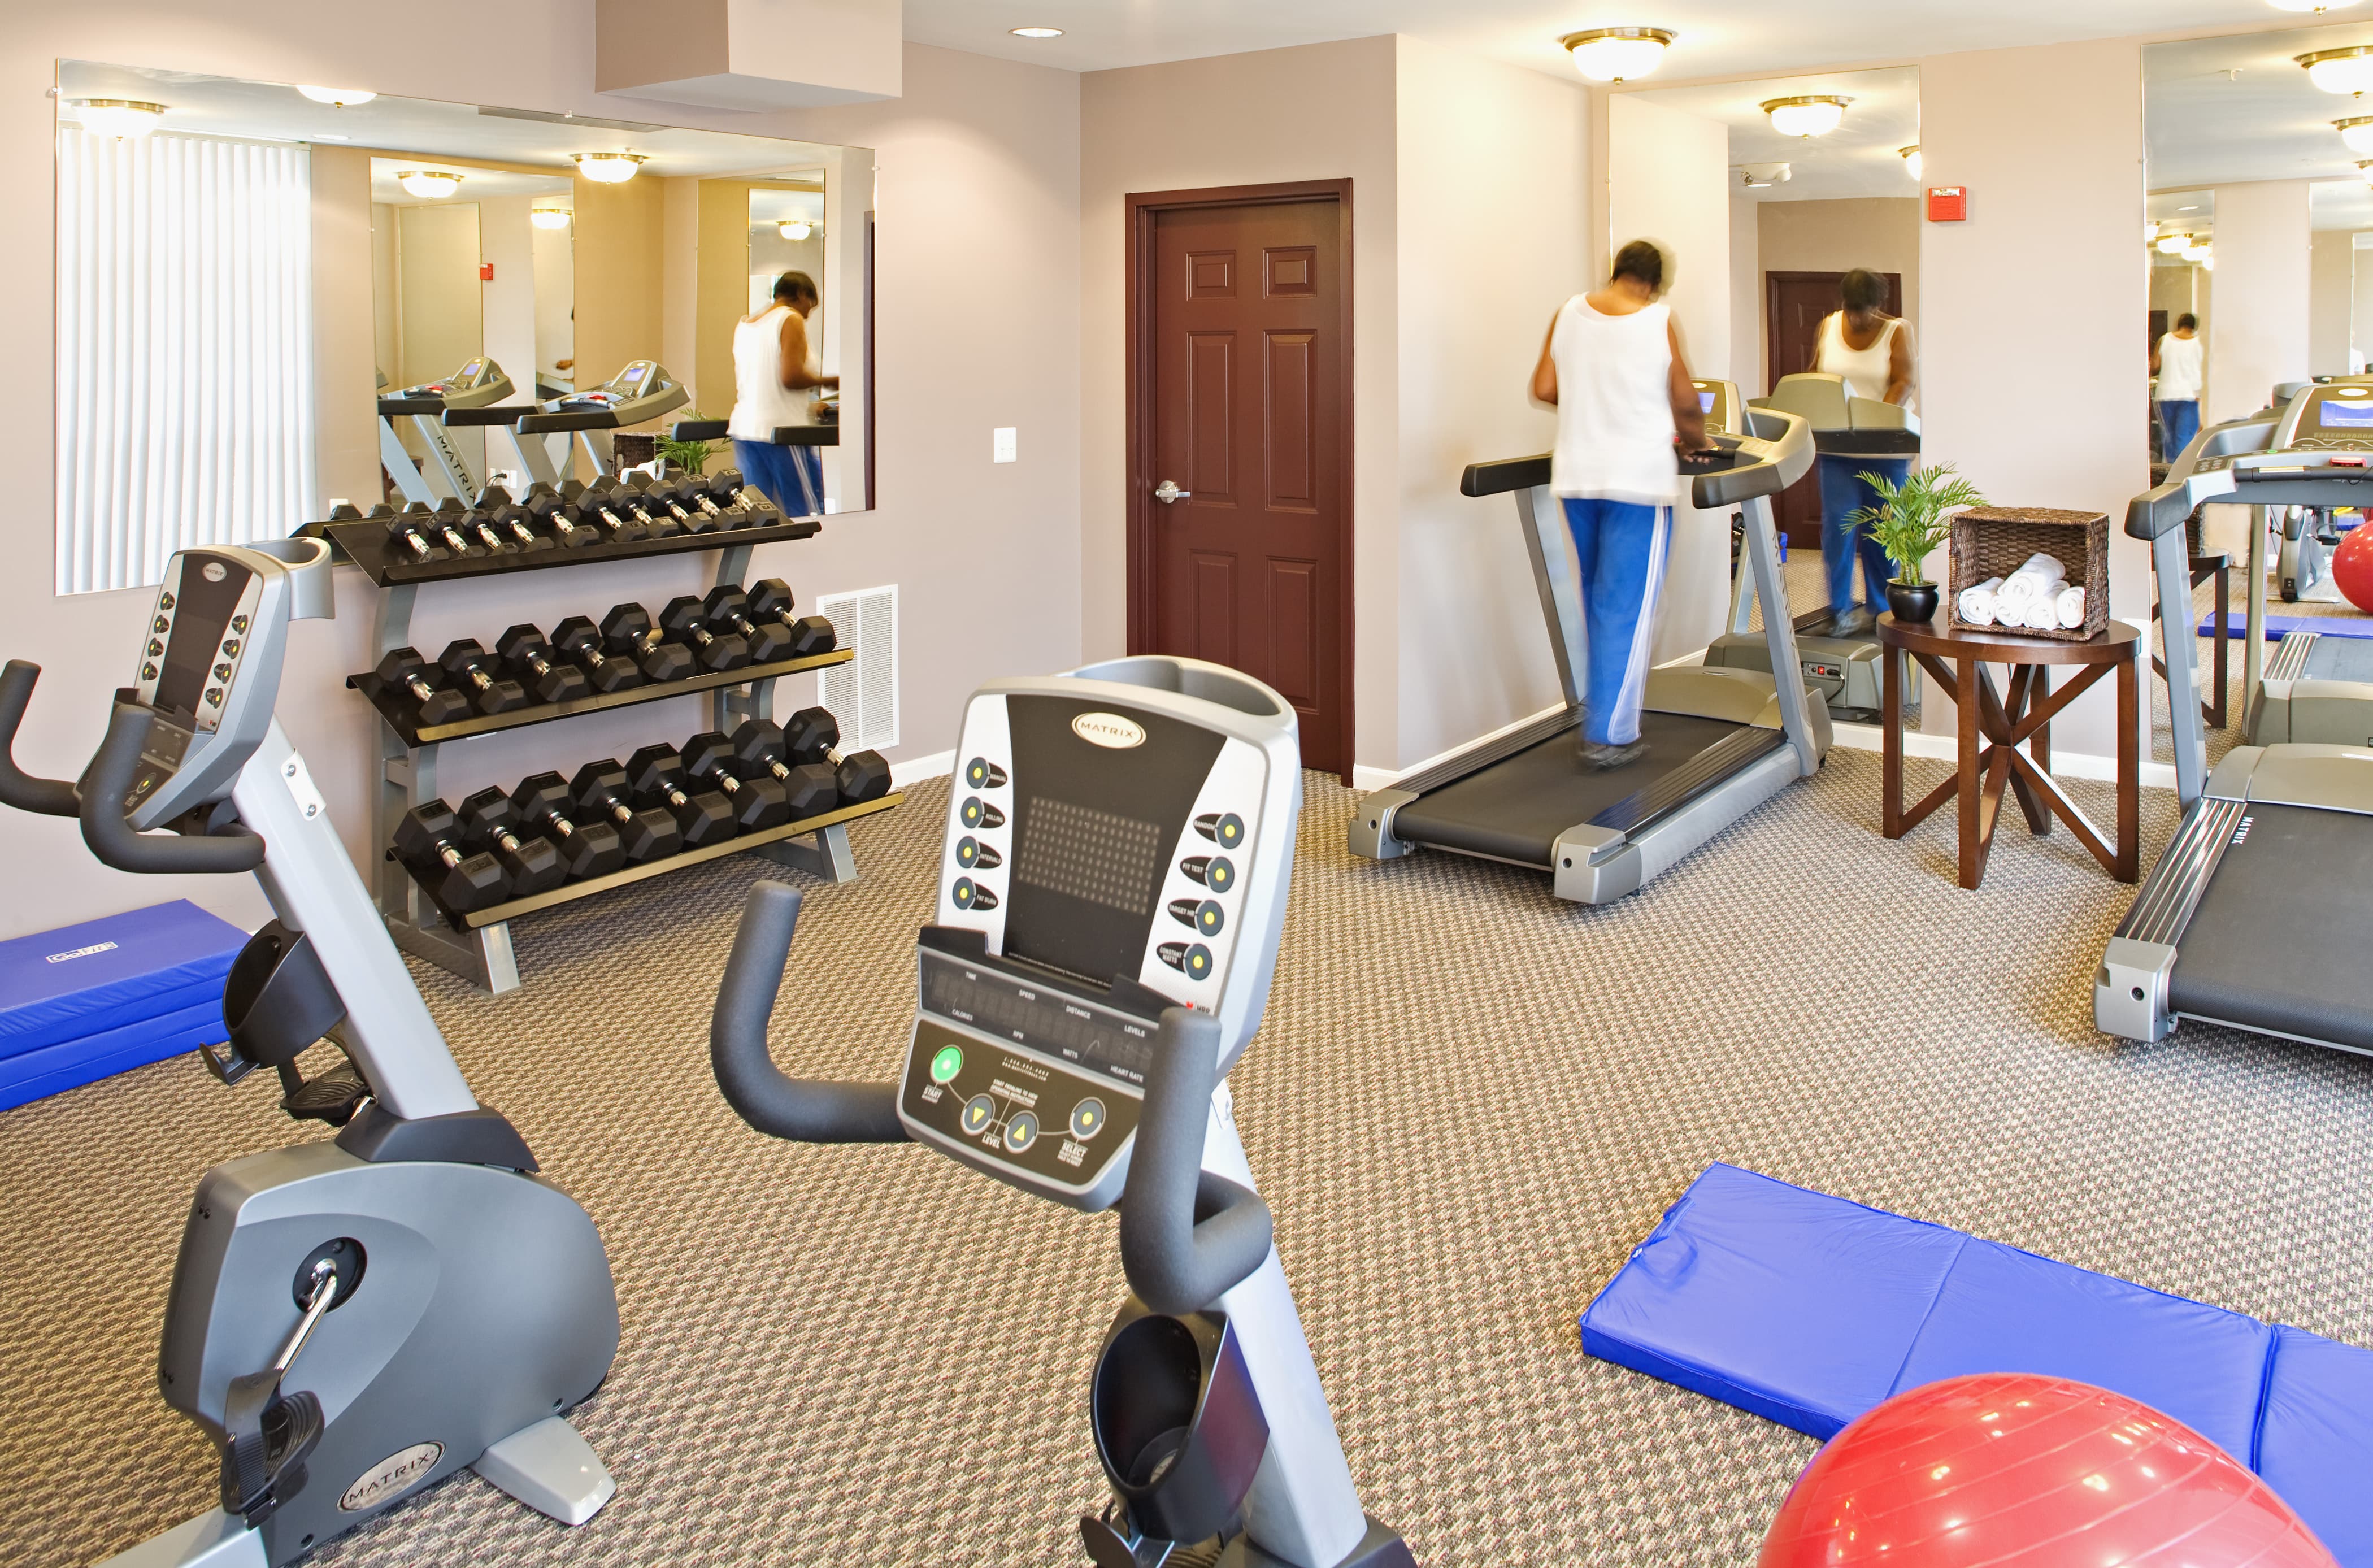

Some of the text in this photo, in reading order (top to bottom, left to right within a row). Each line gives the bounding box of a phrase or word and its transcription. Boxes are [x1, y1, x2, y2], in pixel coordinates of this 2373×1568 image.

[1081, 722, 1133, 738] MATRIX
[985, 813, 1004, 823] ROLLING
[2231, 816, 2254, 844] MATRIX
[980, 853, 1001, 865] INTERVALS
[1182, 862, 1203, 874] FIT TEST
[984, 896, 997, 906] BURN
[1168, 904, 1187, 915] TARGET
[52, 946, 102, 961] GoFit
[1159, 946, 1183, 959] CONSTANT
[966, 971, 977, 981] TIME
[1019, 989, 1036, 1001] SPEED
[952, 1009, 973, 1022] CALORIES
[1066, 1005, 1091, 1020] DISTANCE
[1012, 1030, 1024, 1040] RPM
[1124, 1024, 1145, 1038] LEVELS
[1063, 1048, 1078, 1059] WATTS
[1110, 1064, 1144, 1083] HEART RATE
[923, 1087, 942, 1099] START
[981, 1134, 1000, 1149] LEVEL
[1062, 1141, 1086, 1158] SELECT
[349, 1453, 429, 1502] MATRIX
